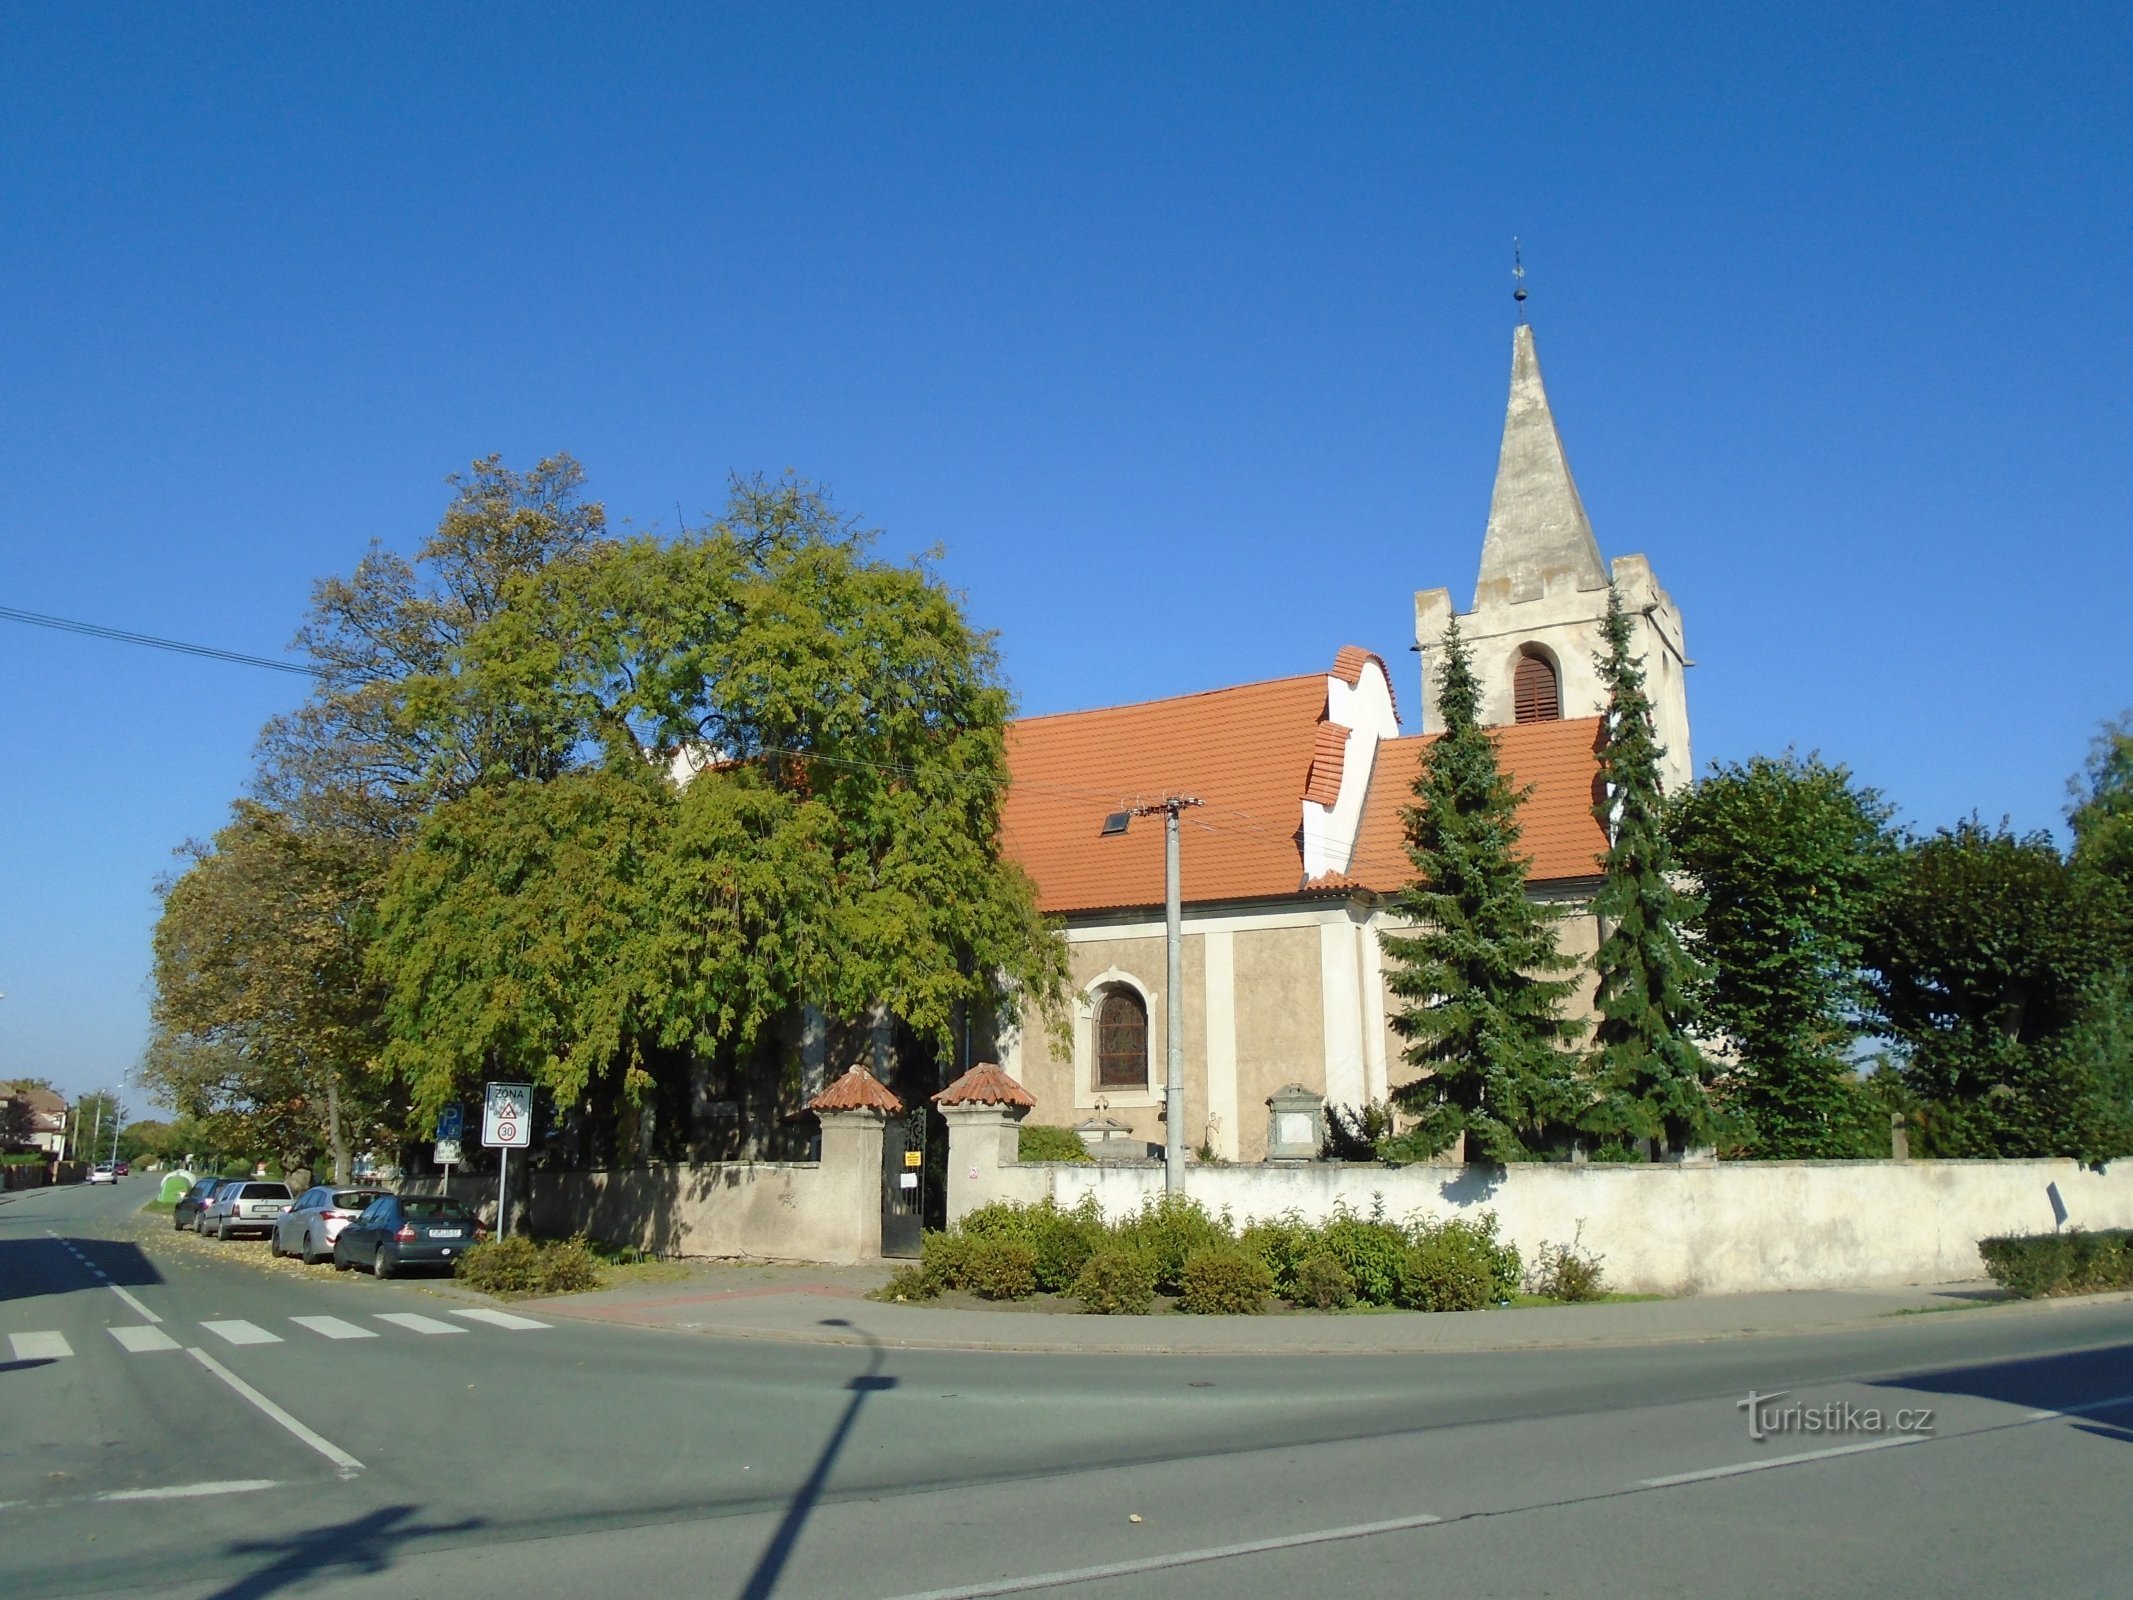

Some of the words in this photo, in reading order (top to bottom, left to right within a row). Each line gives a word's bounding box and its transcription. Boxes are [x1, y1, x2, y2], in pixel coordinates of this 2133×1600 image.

[495, 1088, 524, 1099] ZONA
[443, 1107, 458, 1126] P
[501, 1127, 513, 1137] 30
